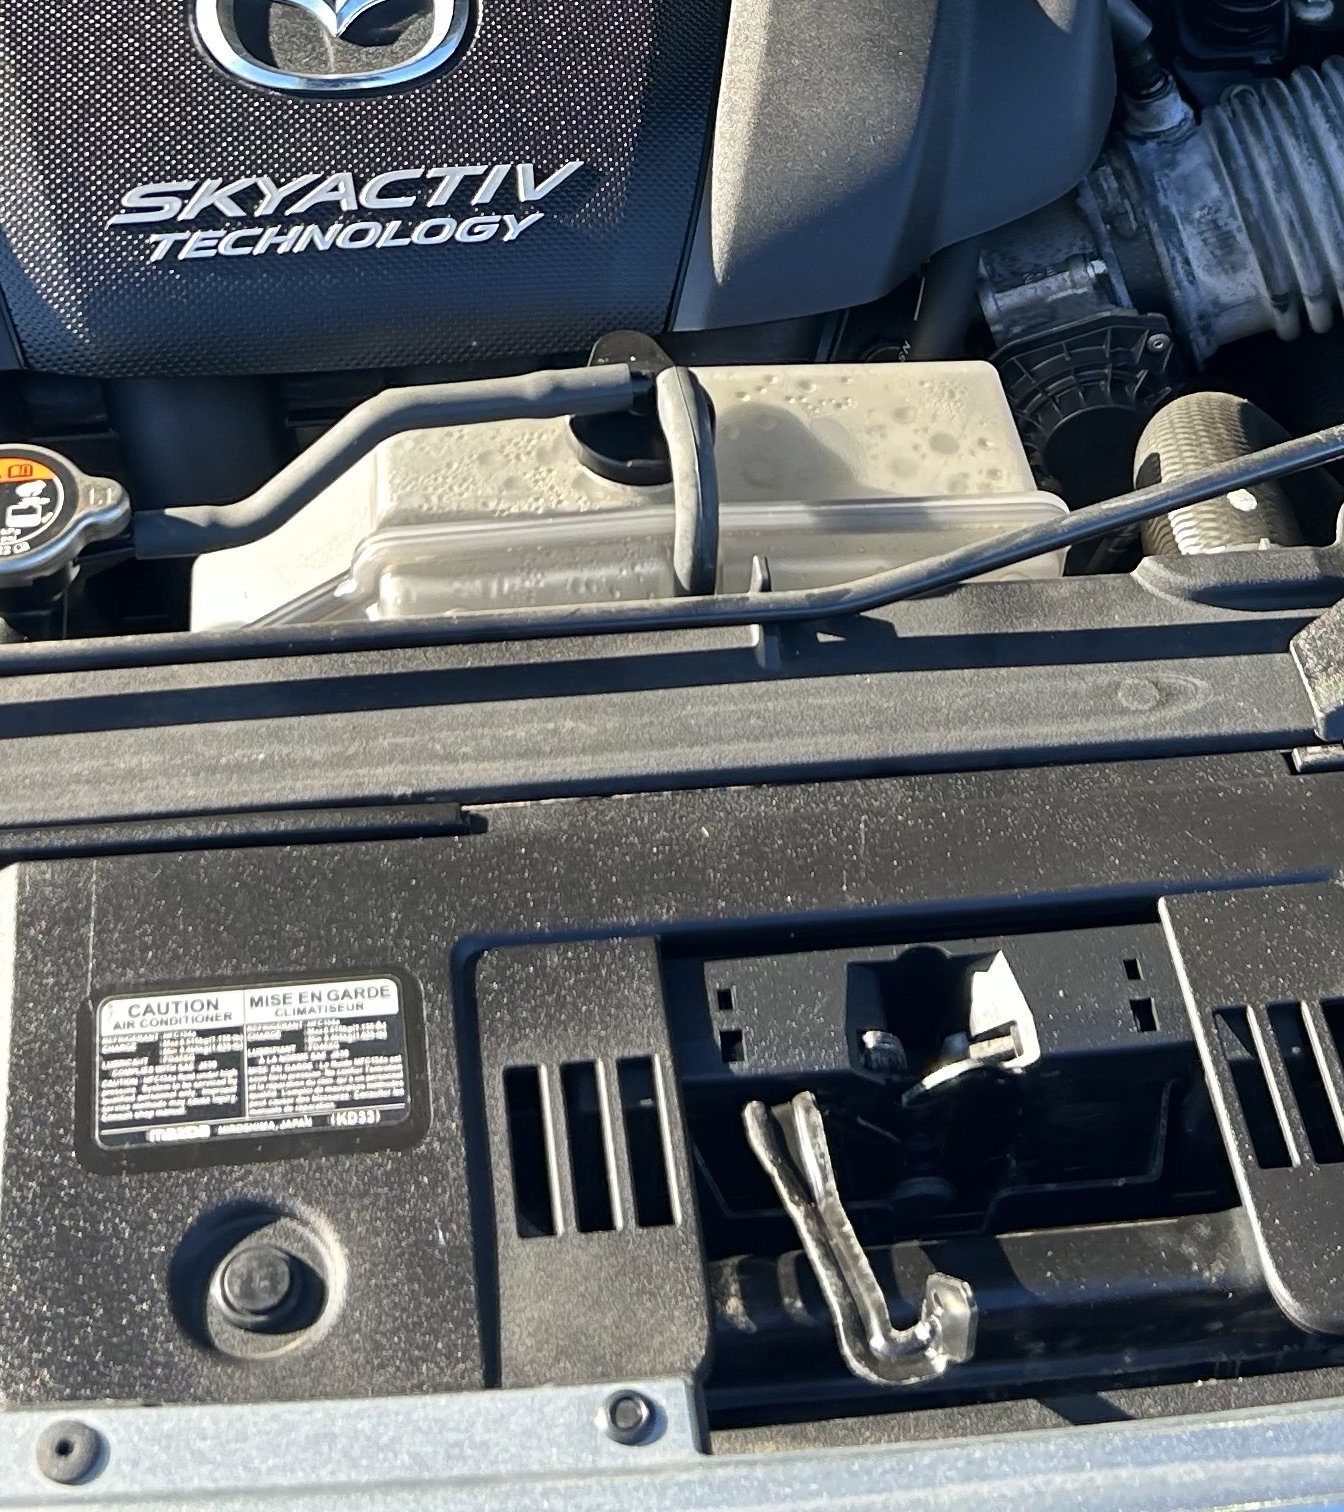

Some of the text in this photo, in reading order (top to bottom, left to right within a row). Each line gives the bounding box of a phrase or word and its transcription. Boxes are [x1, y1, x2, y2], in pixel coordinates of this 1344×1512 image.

[106, 161, 586, 228] SKYACTIV
[148, 212, 545, 263] TECHNOLOGY
[128, 997, 219, 1018] CAUTION
[249, 985, 392, 1008] MISE EN GARDE
[274, 1001, 364, 1017] CLIMATISEUR
[113, 1020, 135, 1031] AIR
[140, 1011, 232, 1028] CONDITIONER
